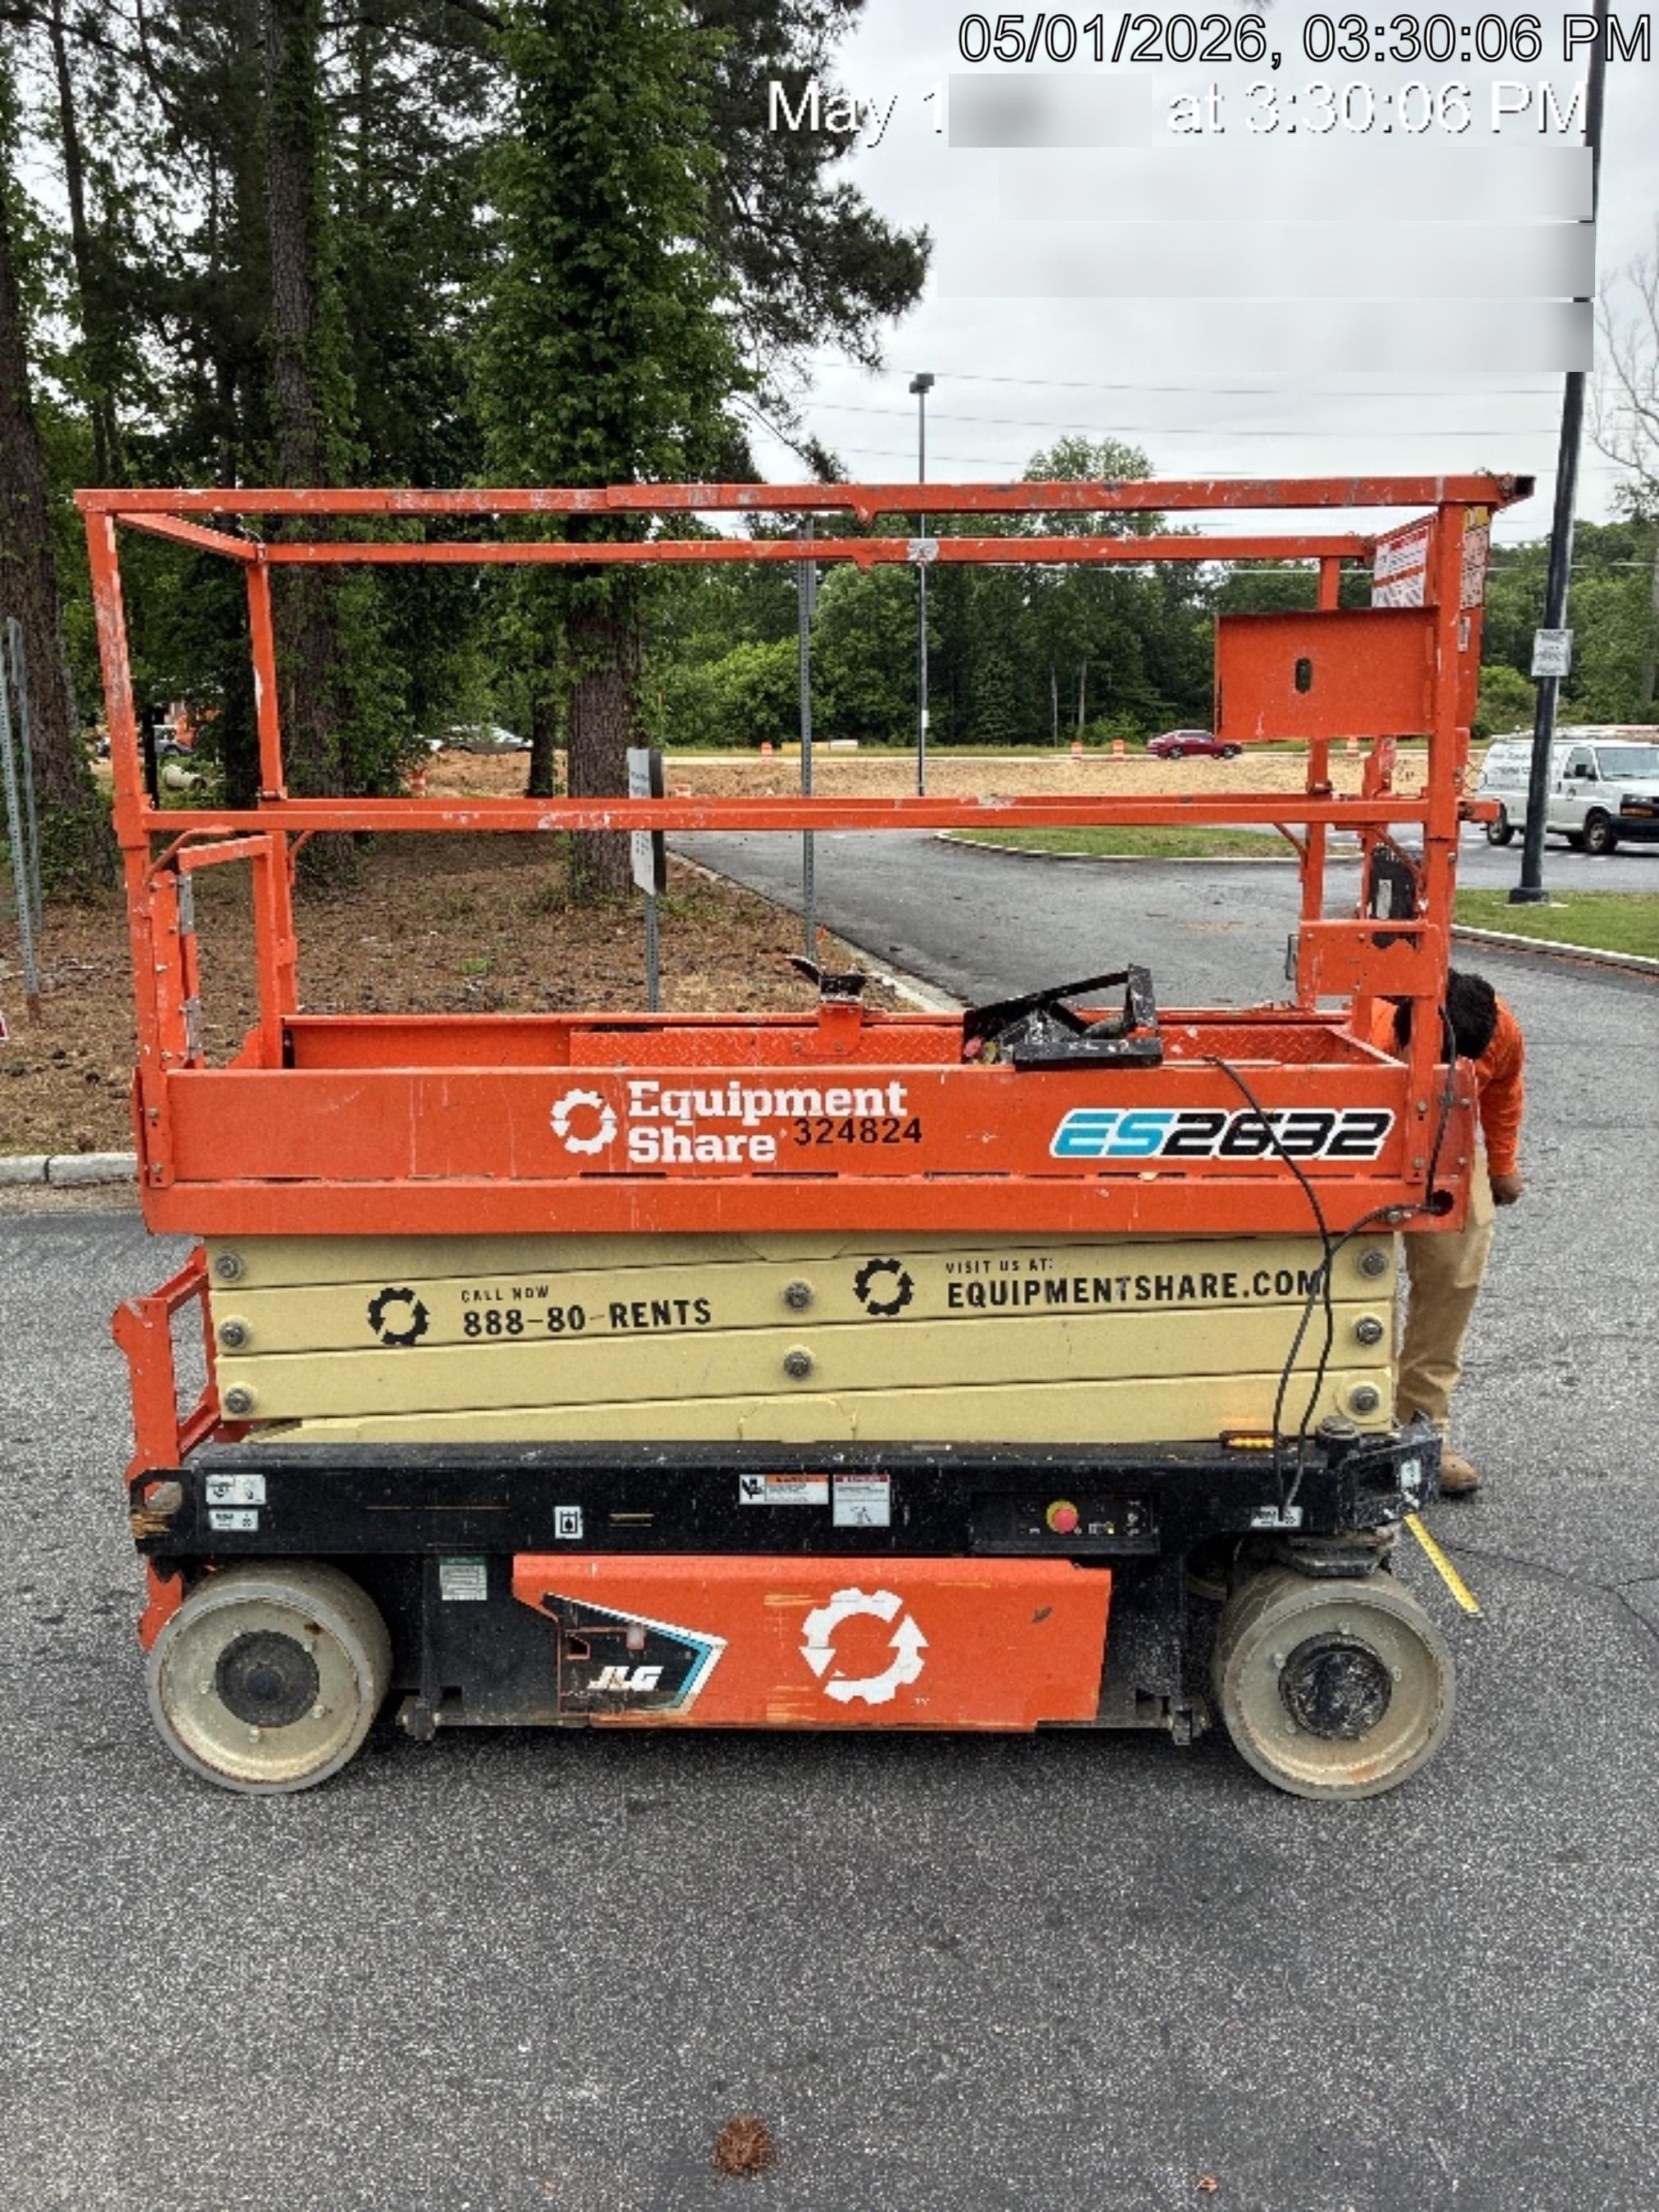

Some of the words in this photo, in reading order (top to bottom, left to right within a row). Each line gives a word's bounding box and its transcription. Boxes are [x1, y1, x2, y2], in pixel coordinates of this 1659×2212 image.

[626, 1080, 909, 1126] Equipment
[627, 1126, 776, 1164] Share
[792, 1117, 923, 1145] 324824
[1049, 1108, 1396, 1160] ES2632
[945, 1258, 990, 1275] VISIT
[999, 1258, 1020, 1272] US
[460, 1287, 504, 1303] CALL
[510, 1285, 550, 1302] NOW
[946, 1269, 1323, 1308] EQUIPMENTSHARE.COM
[463, 1298, 712, 1338] 888-80-RENTS
[586, 1665, 664, 1692] JLG
